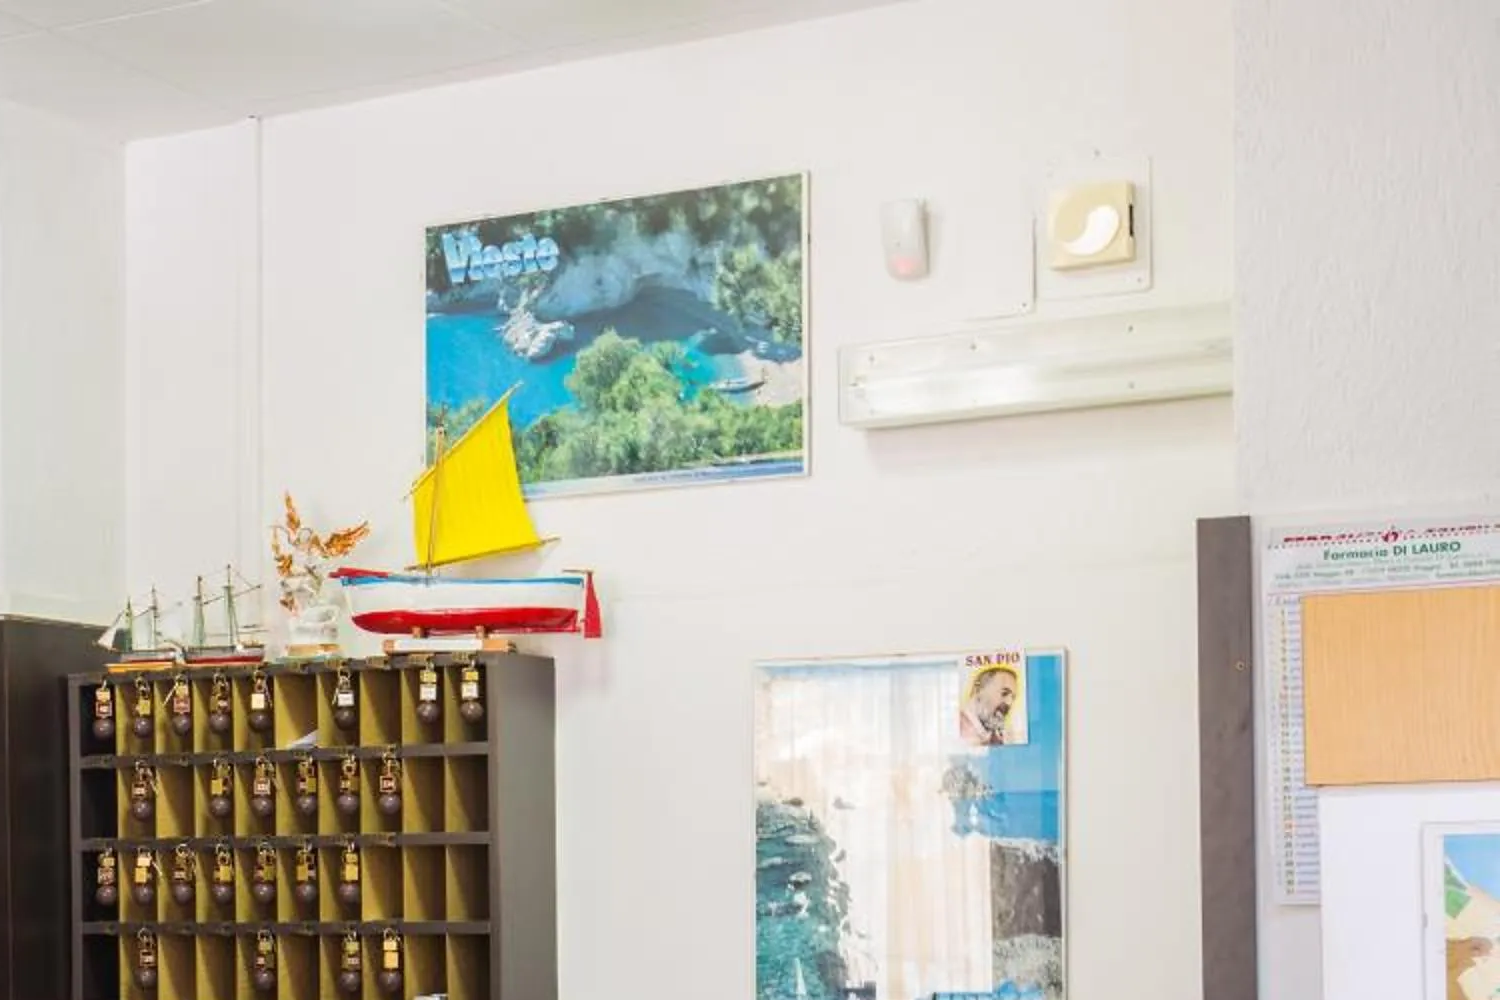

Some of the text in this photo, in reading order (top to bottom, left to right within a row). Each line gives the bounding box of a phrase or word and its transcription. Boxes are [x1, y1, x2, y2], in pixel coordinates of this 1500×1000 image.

[442, 231, 559, 283] Vieste
[1323, 541, 1461, 560] Farmacia DI LAURO
[965, 652, 1020, 667] SAN PIO
